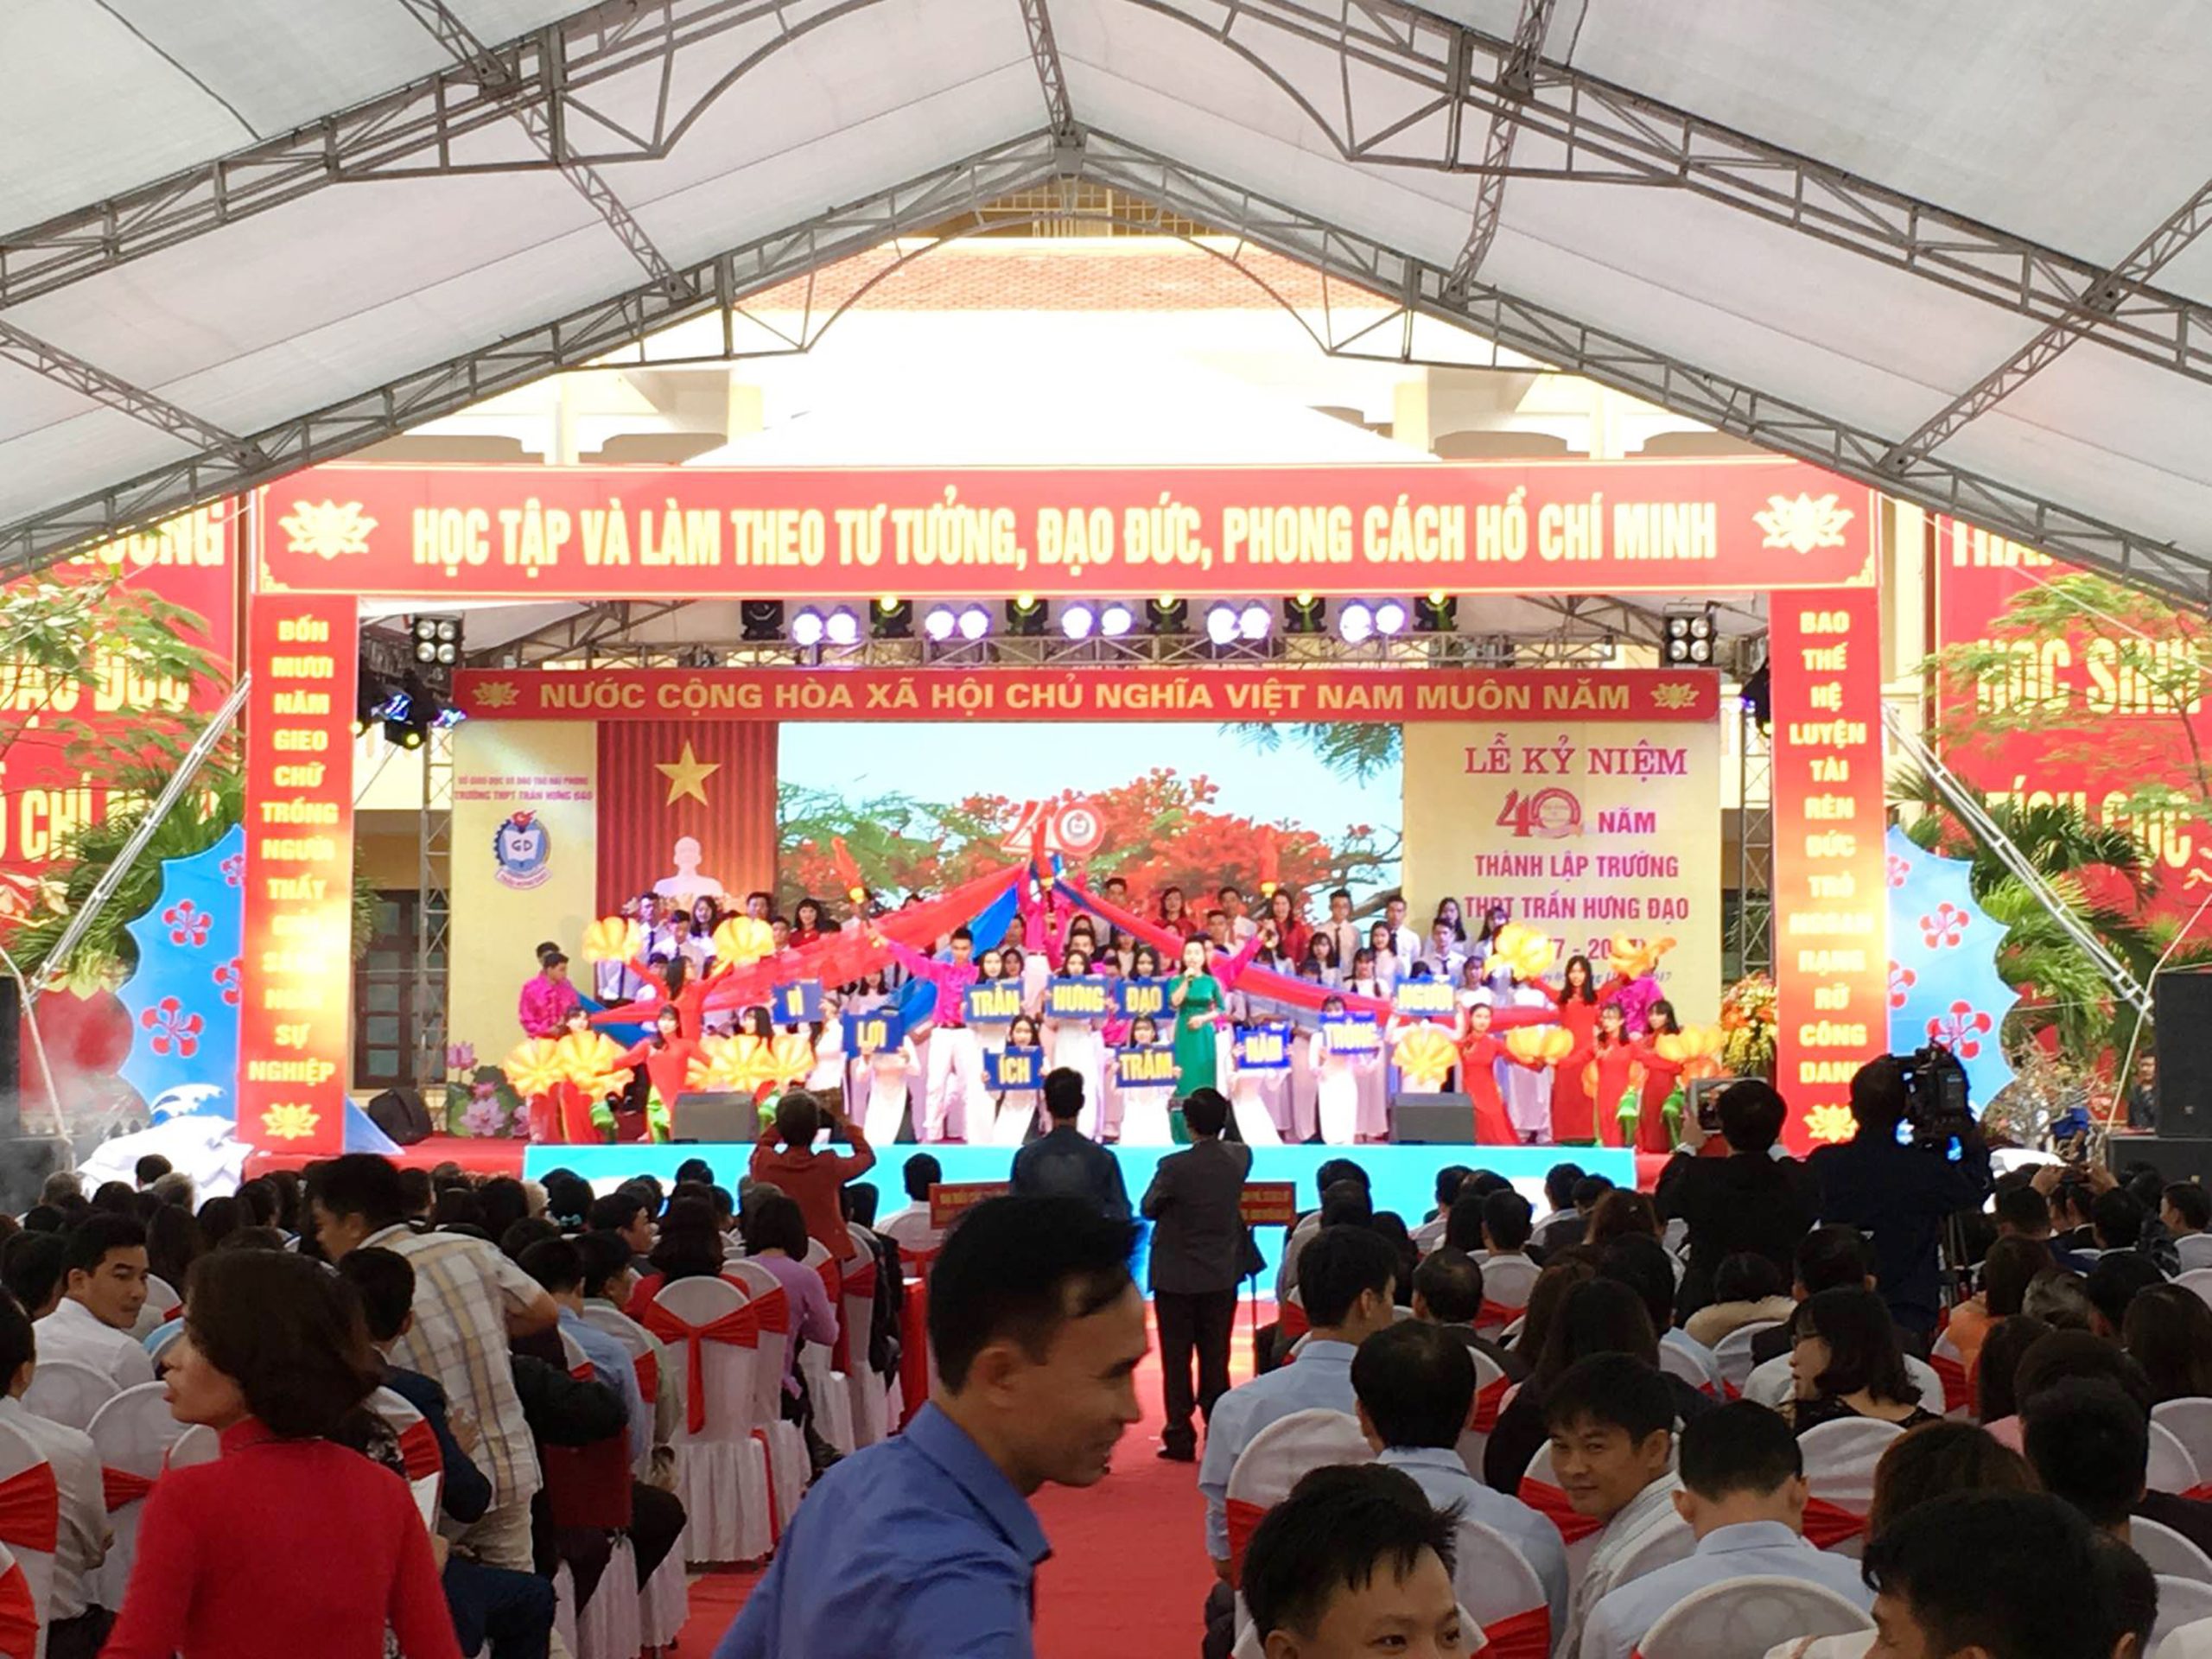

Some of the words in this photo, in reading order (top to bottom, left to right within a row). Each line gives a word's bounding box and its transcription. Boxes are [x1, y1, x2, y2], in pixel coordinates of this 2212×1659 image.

[412, 508, 490, 577] HỌC
[499, 497, 571, 578] TẬP
[580, 497, 631, 565] VÀ
[639, 497, 721, 565] LÀM
[730, 508, 825, 566] THEO
[835, 503, 887, 565] TƯ
[891, 485, 1027, 570] TƯỞNG,
[1037, 507, 1115, 576] ĐẠO
[1123, 492, 1212, 570] ĐỨC,
[1223, 506, 1353, 563] PHONG
[1363, 493, 1465, 563] CÁCH
[1476, 486, 1527, 561] HỒ
[1538, 492, 1604, 560] CHÍ
[1613, 502, 1717, 560] MINH
[278, 613, 329, 642] BỐN
[1800, 611, 1849, 633] BAO
[540, 677, 645, 709] NƯỚC
[658, 677, 762, 715] CỘNG
[776, 677, 854, 709] HÒA
[866, 677, 918, 709] XÃ
[931, 677, 994, 716] HỘI
[1006, 673, 1083, 709] CHỦ
[1096, 677, 1214, 709] NGHĨA
[1225, 677, 1306, 715] VIỆT
[1317, 684, 1403, 709] NAM
[1416, 678, 1529, 709] MUÔN
[1543, 678, 1630, 709] NĂM
[1810, 682, 1842, 712] HỆ
[273, 729, 328, 751] GIEO
[1789, 719, 1866, 749] LUYỆN
[1465, 733, 1510, 774] LỄ
[1522, 734, 1575, 774] KỶ
[1587, 739, 1688, 782] NIỆM
[1496, 787, 1581, 838] 40
[1599, 807, 1656, 833] NĂM
[1475, 849, 1542, 877] THÀNH
[1551, 849, 1588, 882] LẬP
[1596, 849, 1678, 877] TRƯỜNG
[1583, 895, 1640, 919] HƯNG
[1647, 897, 1688, 925] ĐẠO
[275, 1023, 311, 1049] SỰ
[1799, 1020, 1866, 1046] CÔNG
[248, 1058, 336, 1086] NGHIỆP
[1799, 1061, 1866, 1084] DAN
